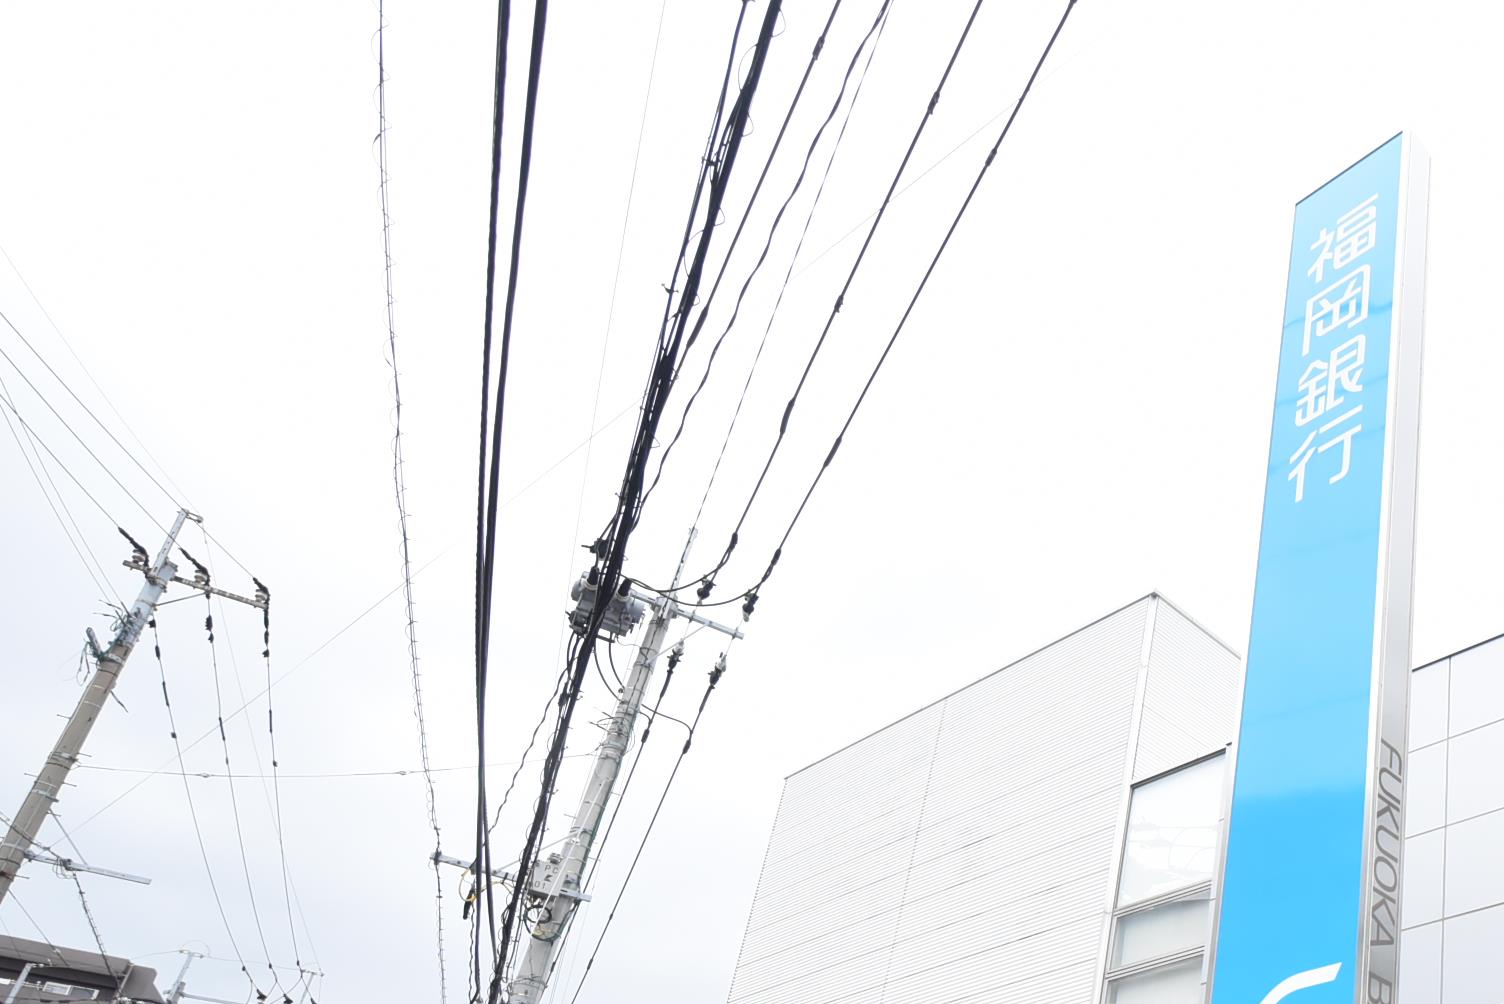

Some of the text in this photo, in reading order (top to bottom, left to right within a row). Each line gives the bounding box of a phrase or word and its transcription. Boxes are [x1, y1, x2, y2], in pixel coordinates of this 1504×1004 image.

[1288, 193, 1379, 503] 福岡銀行
[1368, 737, 1402, 946] FUKUOKA
